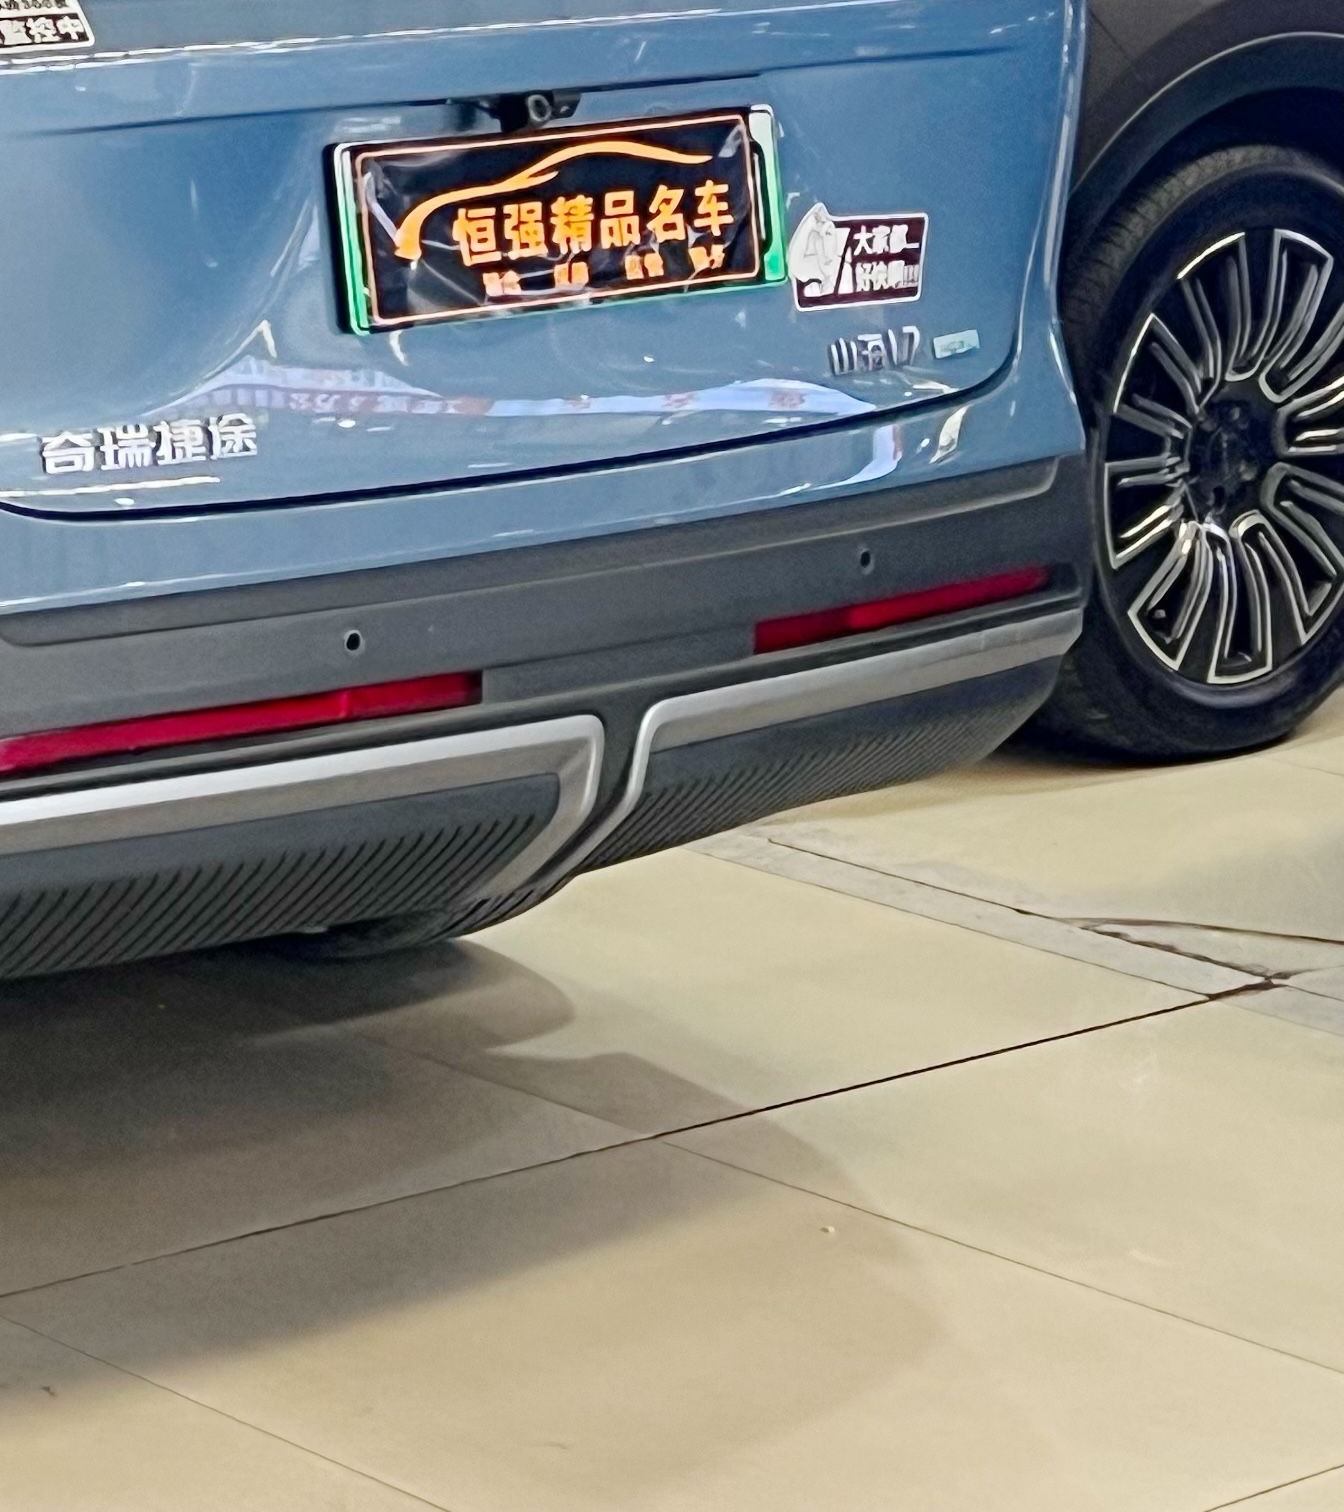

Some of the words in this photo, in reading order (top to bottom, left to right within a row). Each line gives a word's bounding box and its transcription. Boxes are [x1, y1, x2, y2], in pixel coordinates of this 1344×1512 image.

[452, 179, 736, 267] 恒强精品名车
[41, 412, 258, 475] 奇瑞捷途
